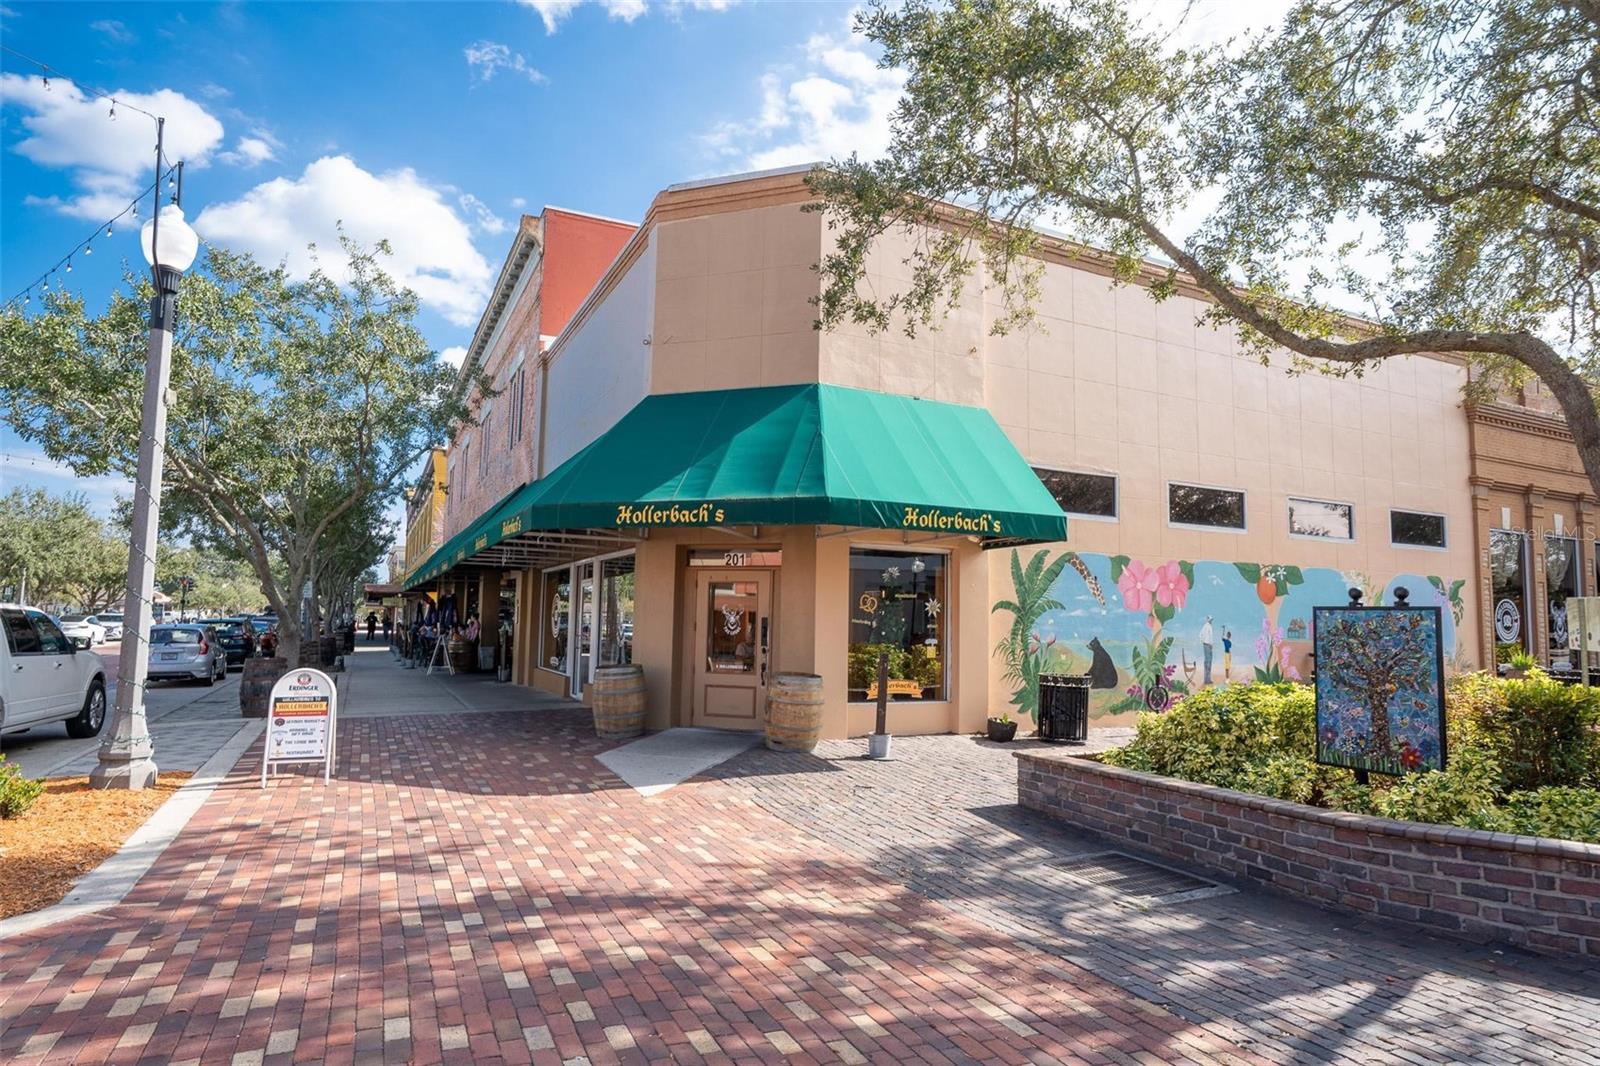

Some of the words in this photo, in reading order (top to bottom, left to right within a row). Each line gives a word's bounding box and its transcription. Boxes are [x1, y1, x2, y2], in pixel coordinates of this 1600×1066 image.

[616, 503, 725, 525] Hollerbach's
[902, 507, 1001, 533] Hollerbach's
[725, 553, 746, 566] 201
